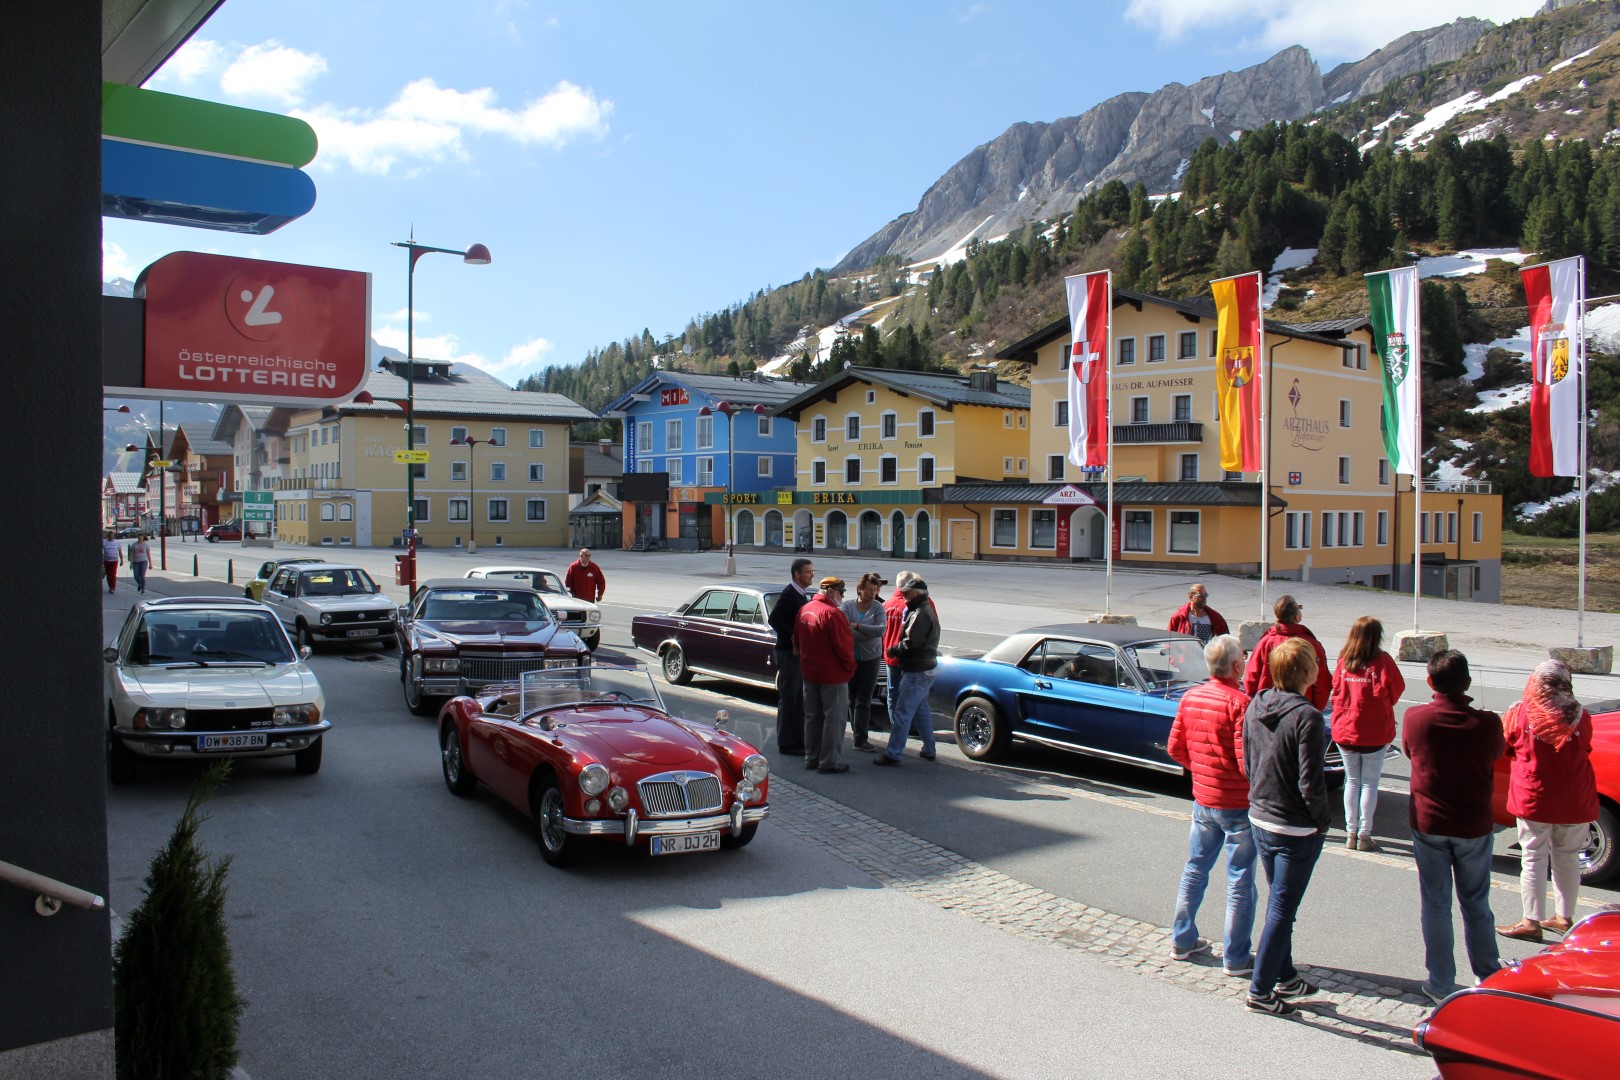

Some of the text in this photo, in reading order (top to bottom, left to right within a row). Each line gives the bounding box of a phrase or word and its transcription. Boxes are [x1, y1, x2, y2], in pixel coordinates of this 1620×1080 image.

[178, 348, 337, 371] österreichische
[178, 364, 336, 389] LOTTERIEN
[1130, 381, 1145, 390] DR.
[1146, 377, 1194, 389] AUFMESSER
[662, 388, 689, 403] MIA
[1283, 416, 1330, 435] ARZTHAUS
[858, 443, 884, 451] ERIKA
[904, 441, 923, 449] Pension
[723, 493, 757, 504] SPORT
[813, 492, 855, 503] ERIKA
[1060, 490, 1077, 498] ARZT
[228, 735, 249, 746] 387
[250, 735, 264, 745] BN
[661, 834, 718, 851] NR DJ 2H
